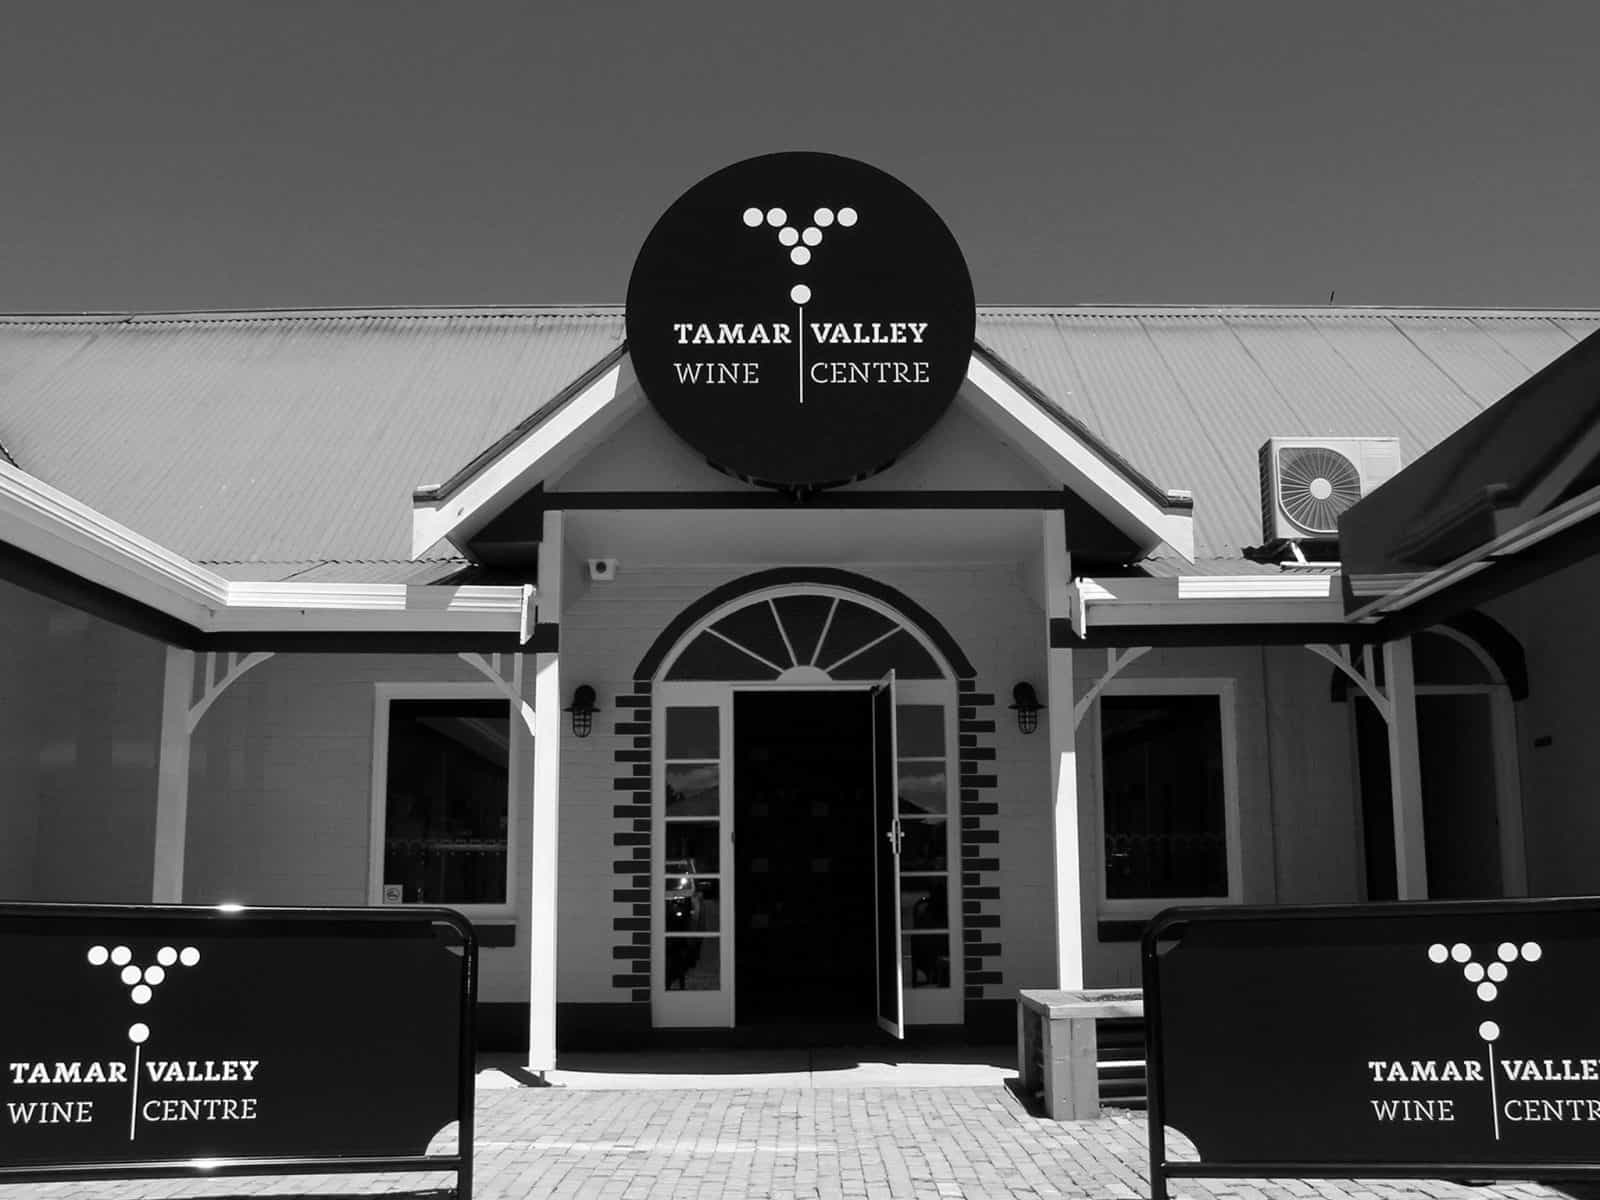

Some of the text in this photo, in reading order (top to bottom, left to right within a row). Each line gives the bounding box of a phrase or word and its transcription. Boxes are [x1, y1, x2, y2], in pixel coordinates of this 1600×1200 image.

[673, 322, 928, 345] TAMAR VALLEY
[673, 362, 930, 384] WINE CENTRE
[9, 1060, 259, 1084] TAMAR VALLEY
[1368, 1059, 1600, 1082] TAMAR VALLE
[7, 1098, 257, 1124] WINE CENTRE
[1370, 1099, 1455, 1121] WINE
